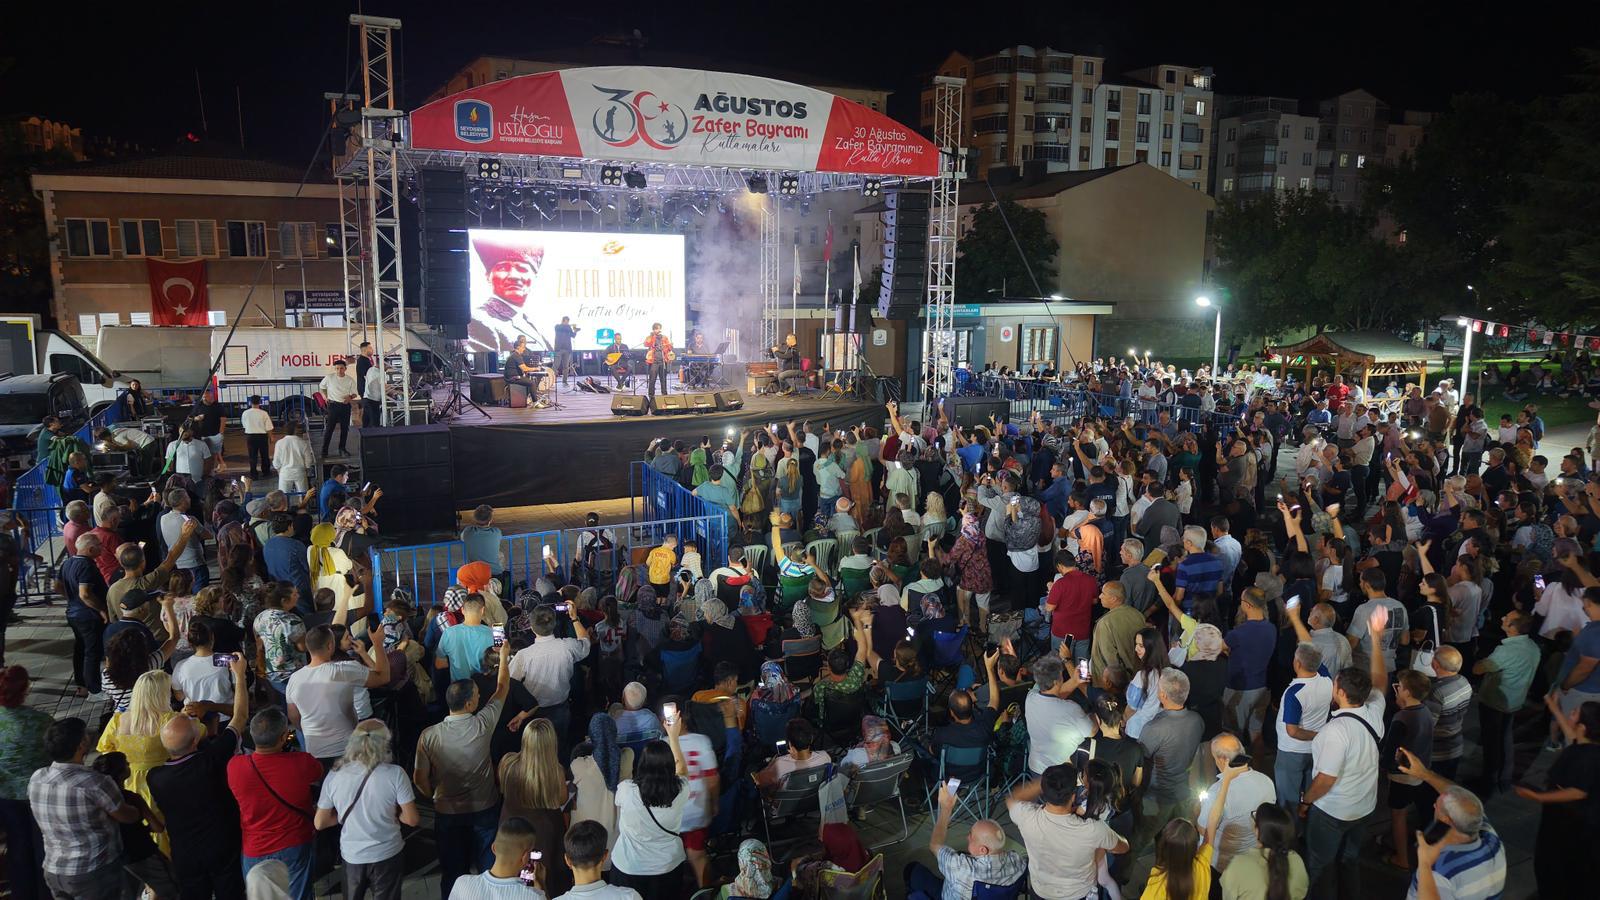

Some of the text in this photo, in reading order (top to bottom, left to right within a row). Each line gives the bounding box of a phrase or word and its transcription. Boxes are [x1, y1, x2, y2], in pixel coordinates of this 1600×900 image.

[694, 92, 807, 119] AĞUSTOS
[692, 115, 808, 139] Zafer Bayramı
[854, 127, 907, 142] 30 Ağustos
[835, 137, 923, 155] Zafer Bayramımız
[557, 269, 672, 298] ZAFER BAYRAMI
[281, 351, 321, 367] MOBİL
